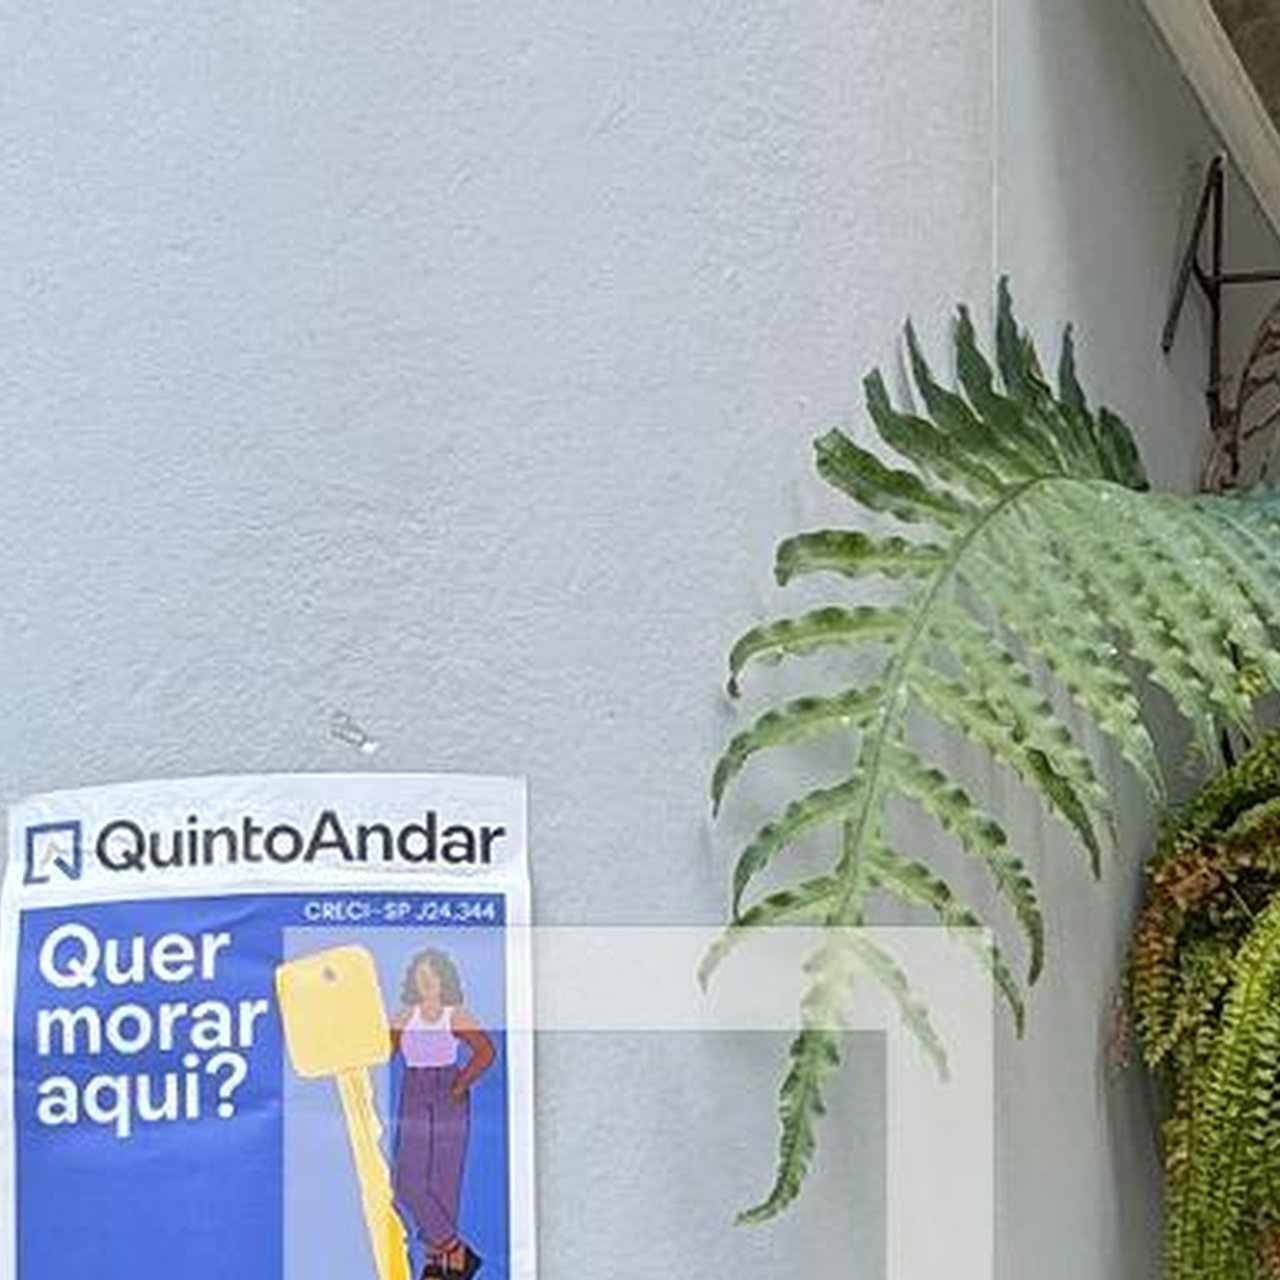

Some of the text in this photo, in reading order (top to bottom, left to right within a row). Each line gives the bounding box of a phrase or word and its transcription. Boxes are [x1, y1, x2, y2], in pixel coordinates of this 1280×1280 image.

[95, 810, 506, 872] QuintoAndar
[39, 924, 231, 988] Quer
[36, 999, 268, 1055] morar
[36, 1052, 248, 1137] aqui?
